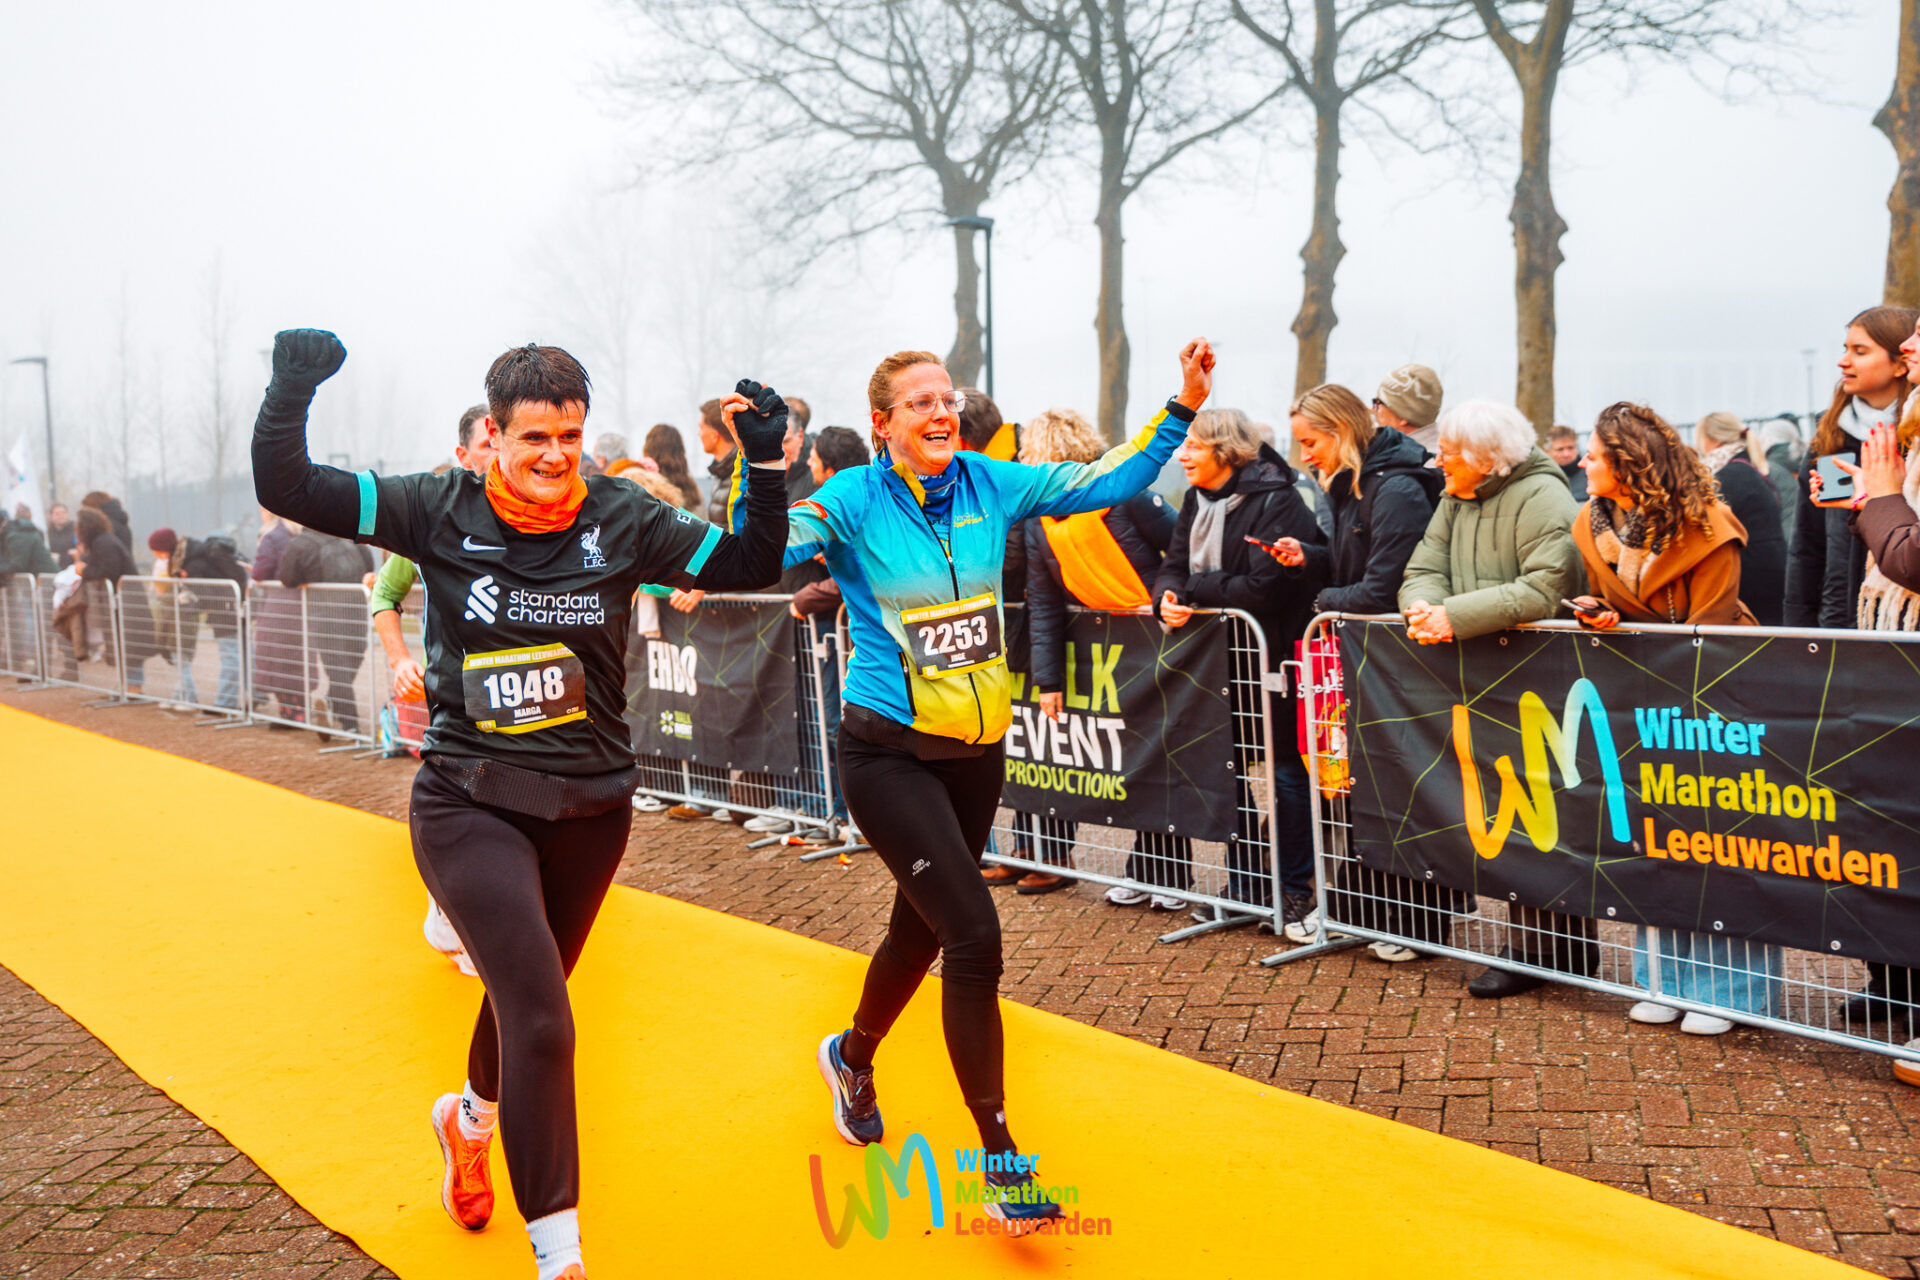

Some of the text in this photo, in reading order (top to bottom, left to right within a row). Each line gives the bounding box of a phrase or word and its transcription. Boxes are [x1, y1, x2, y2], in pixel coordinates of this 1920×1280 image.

[506, 605, 605, 625] chartered
[918, 615, 988, 657] 2253
[483, 666, 565, 709] 1948
[513, 706, 542, 719] MARGA
[1634, 706, 1766, 756] Winter
[1005, 705, 1126, 771] EVENT
[1005, 758, 1127, 801] PRODUCTIONS
[1639, 762, 1836, 822] Marathon
[1643, 817, 1899, 889] Leeuwarden
